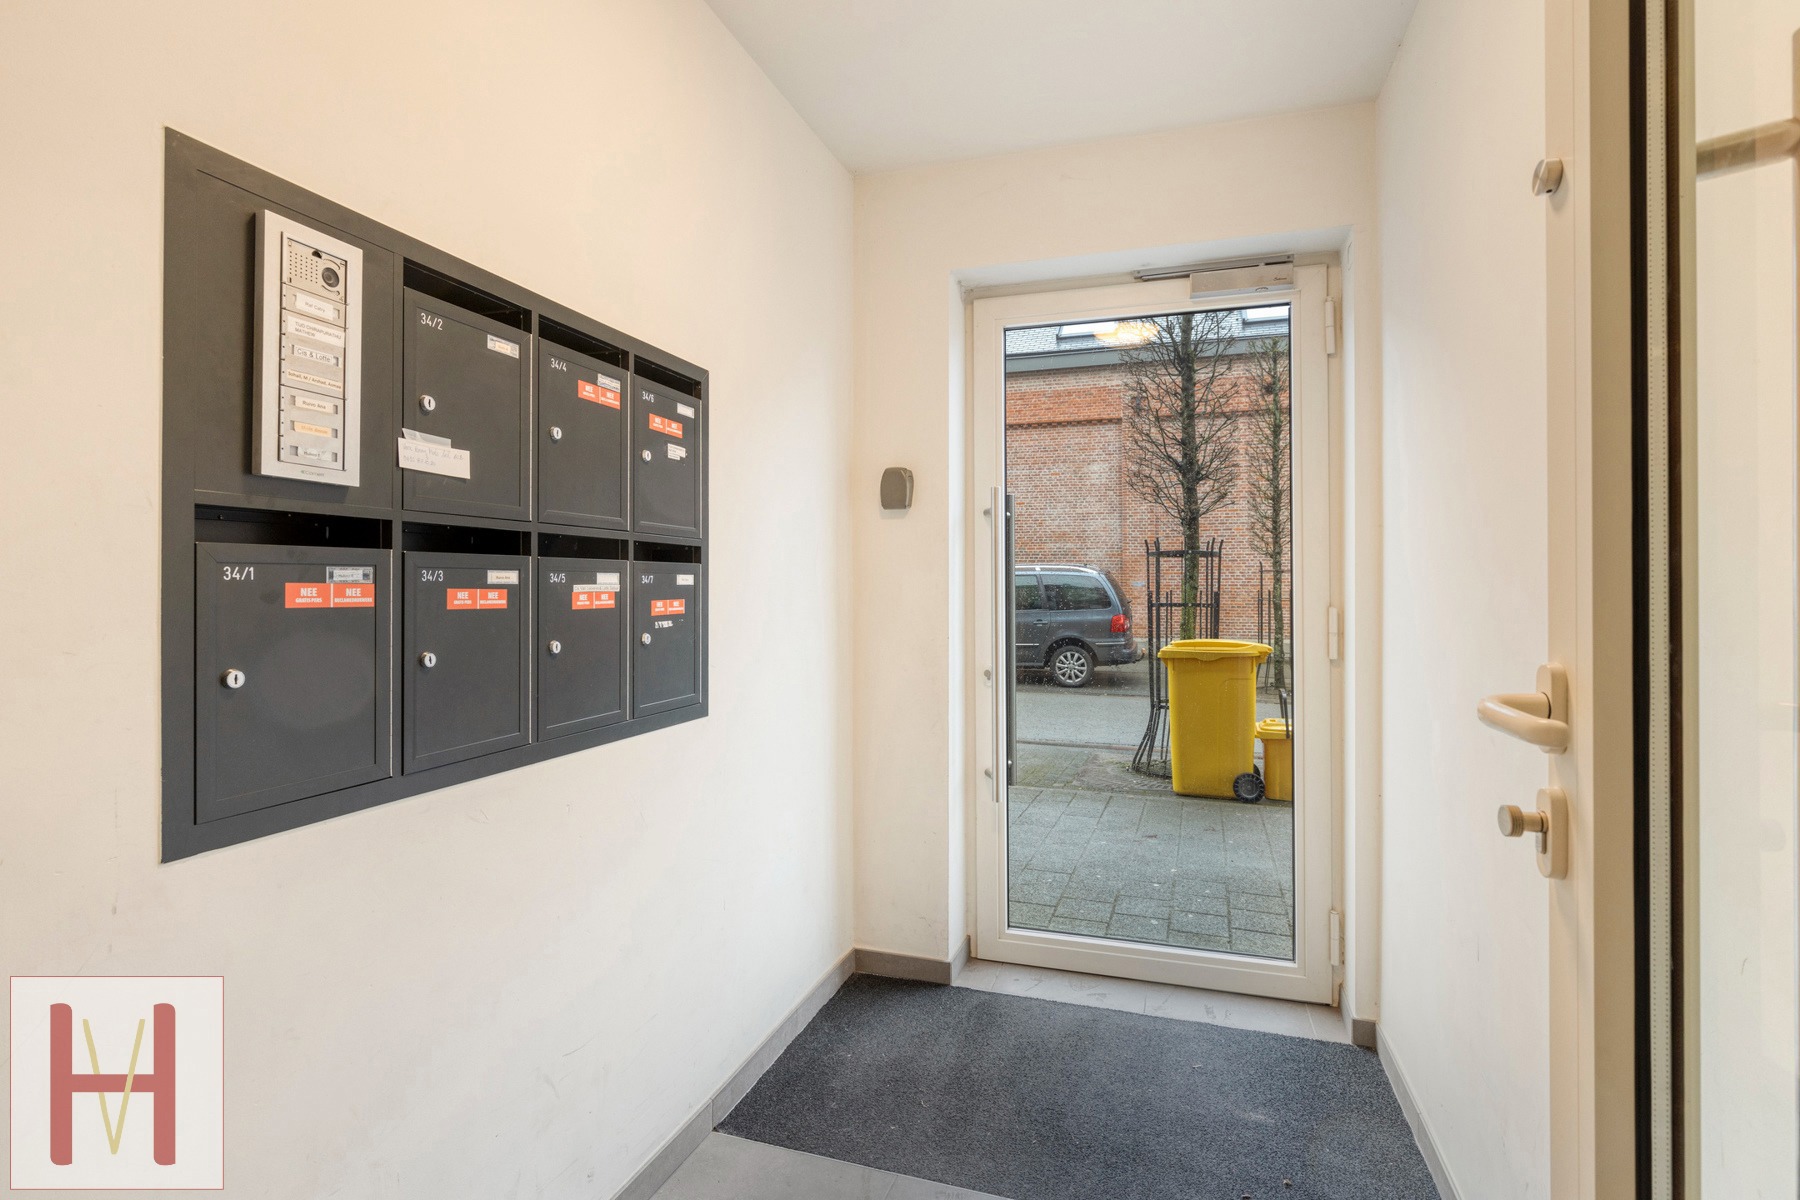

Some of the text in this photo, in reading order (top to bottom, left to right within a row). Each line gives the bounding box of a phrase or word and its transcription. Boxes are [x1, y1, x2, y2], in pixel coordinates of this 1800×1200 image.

[421, 313, 443, 330] 34/2
[550, 358, 567, 372] 34/4
[642, 391, 654, 402] 34/6
[223, 566, 254, 580] 34/1
[421, 570, 444, 581] 34/3
[549, 573, 566, 583] 34/5
[641, 575, 654, 584] 34/7
[300, 588, 317, 596] NEE
[345, 588, 361, 596] NEE
